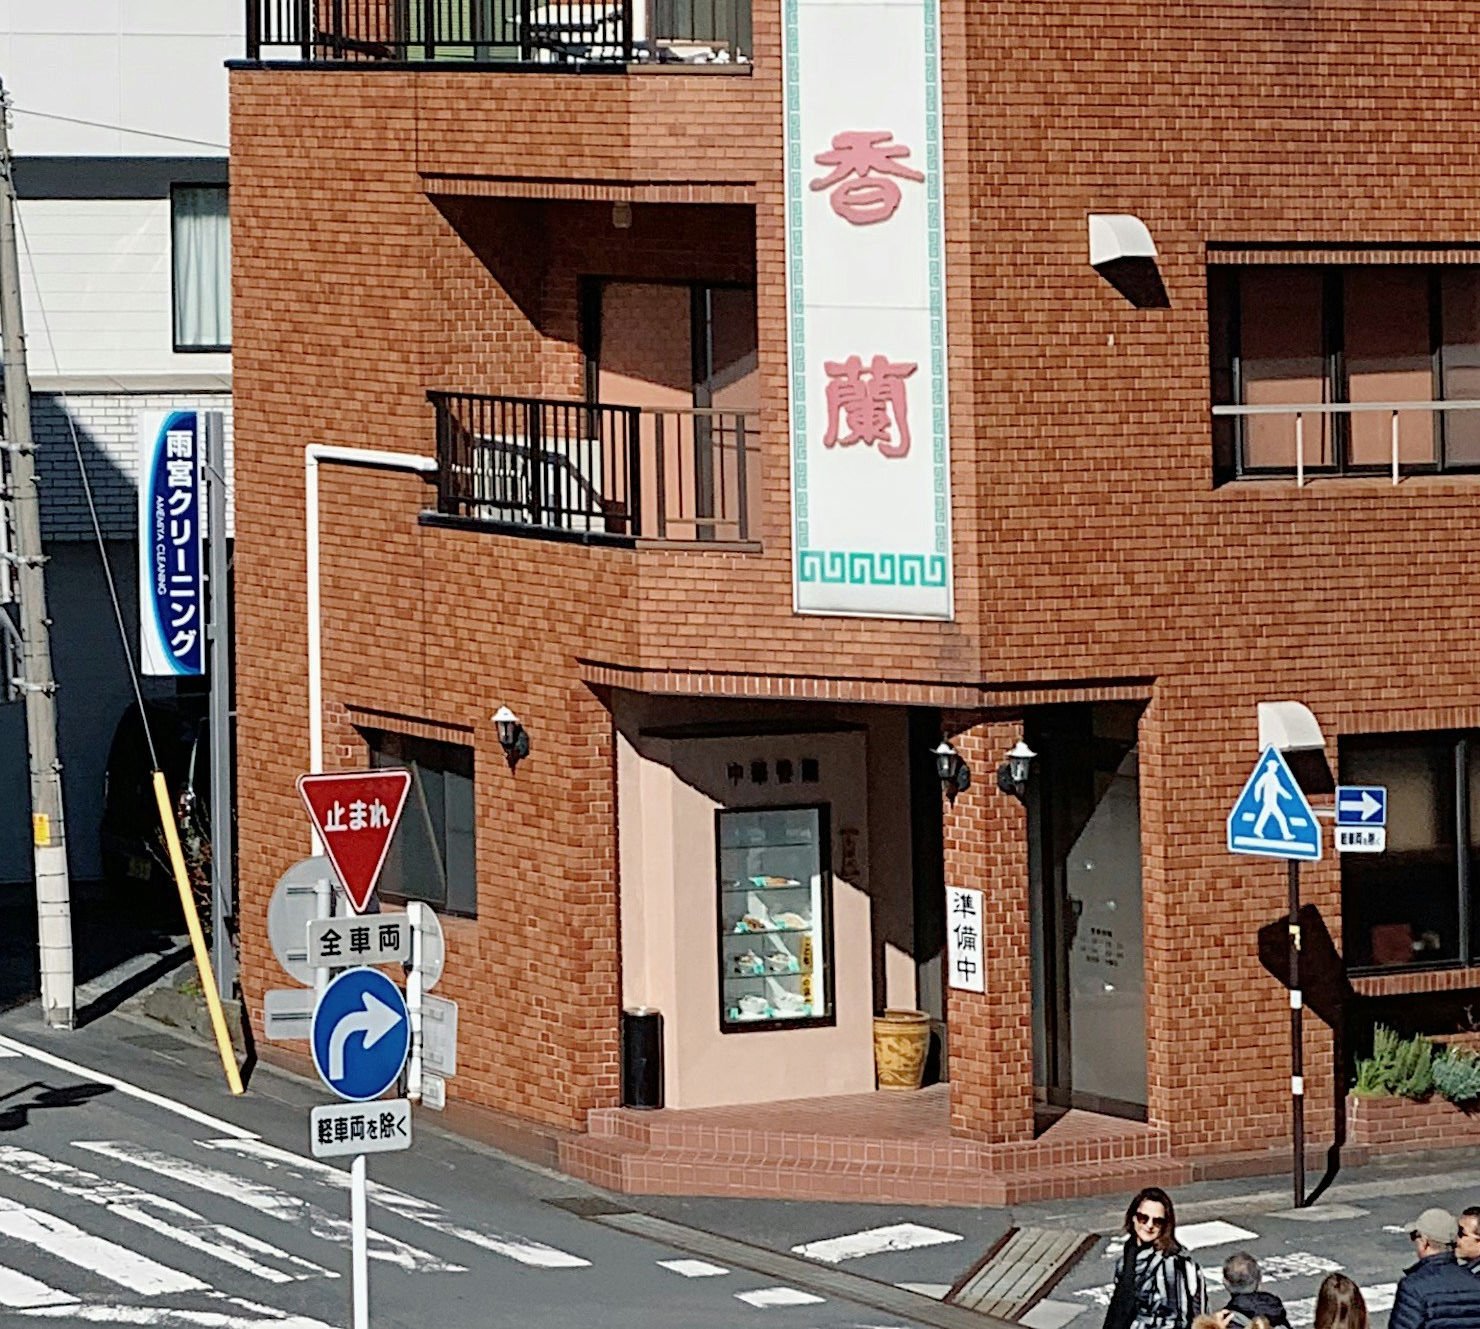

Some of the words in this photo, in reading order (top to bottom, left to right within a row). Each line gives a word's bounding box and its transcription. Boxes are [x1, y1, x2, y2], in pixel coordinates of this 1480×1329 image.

[166, 430, 197, 657] 雨宮クリーニング
[156, 543, 167, 596] CLEANING
[323, 798, 391, 832] 止まれ
[320, 923, 400, 957] 全車両
[953, 891, 978, 983] 準備中
[317, 1112, 408, 1145] 軽車両を除く
